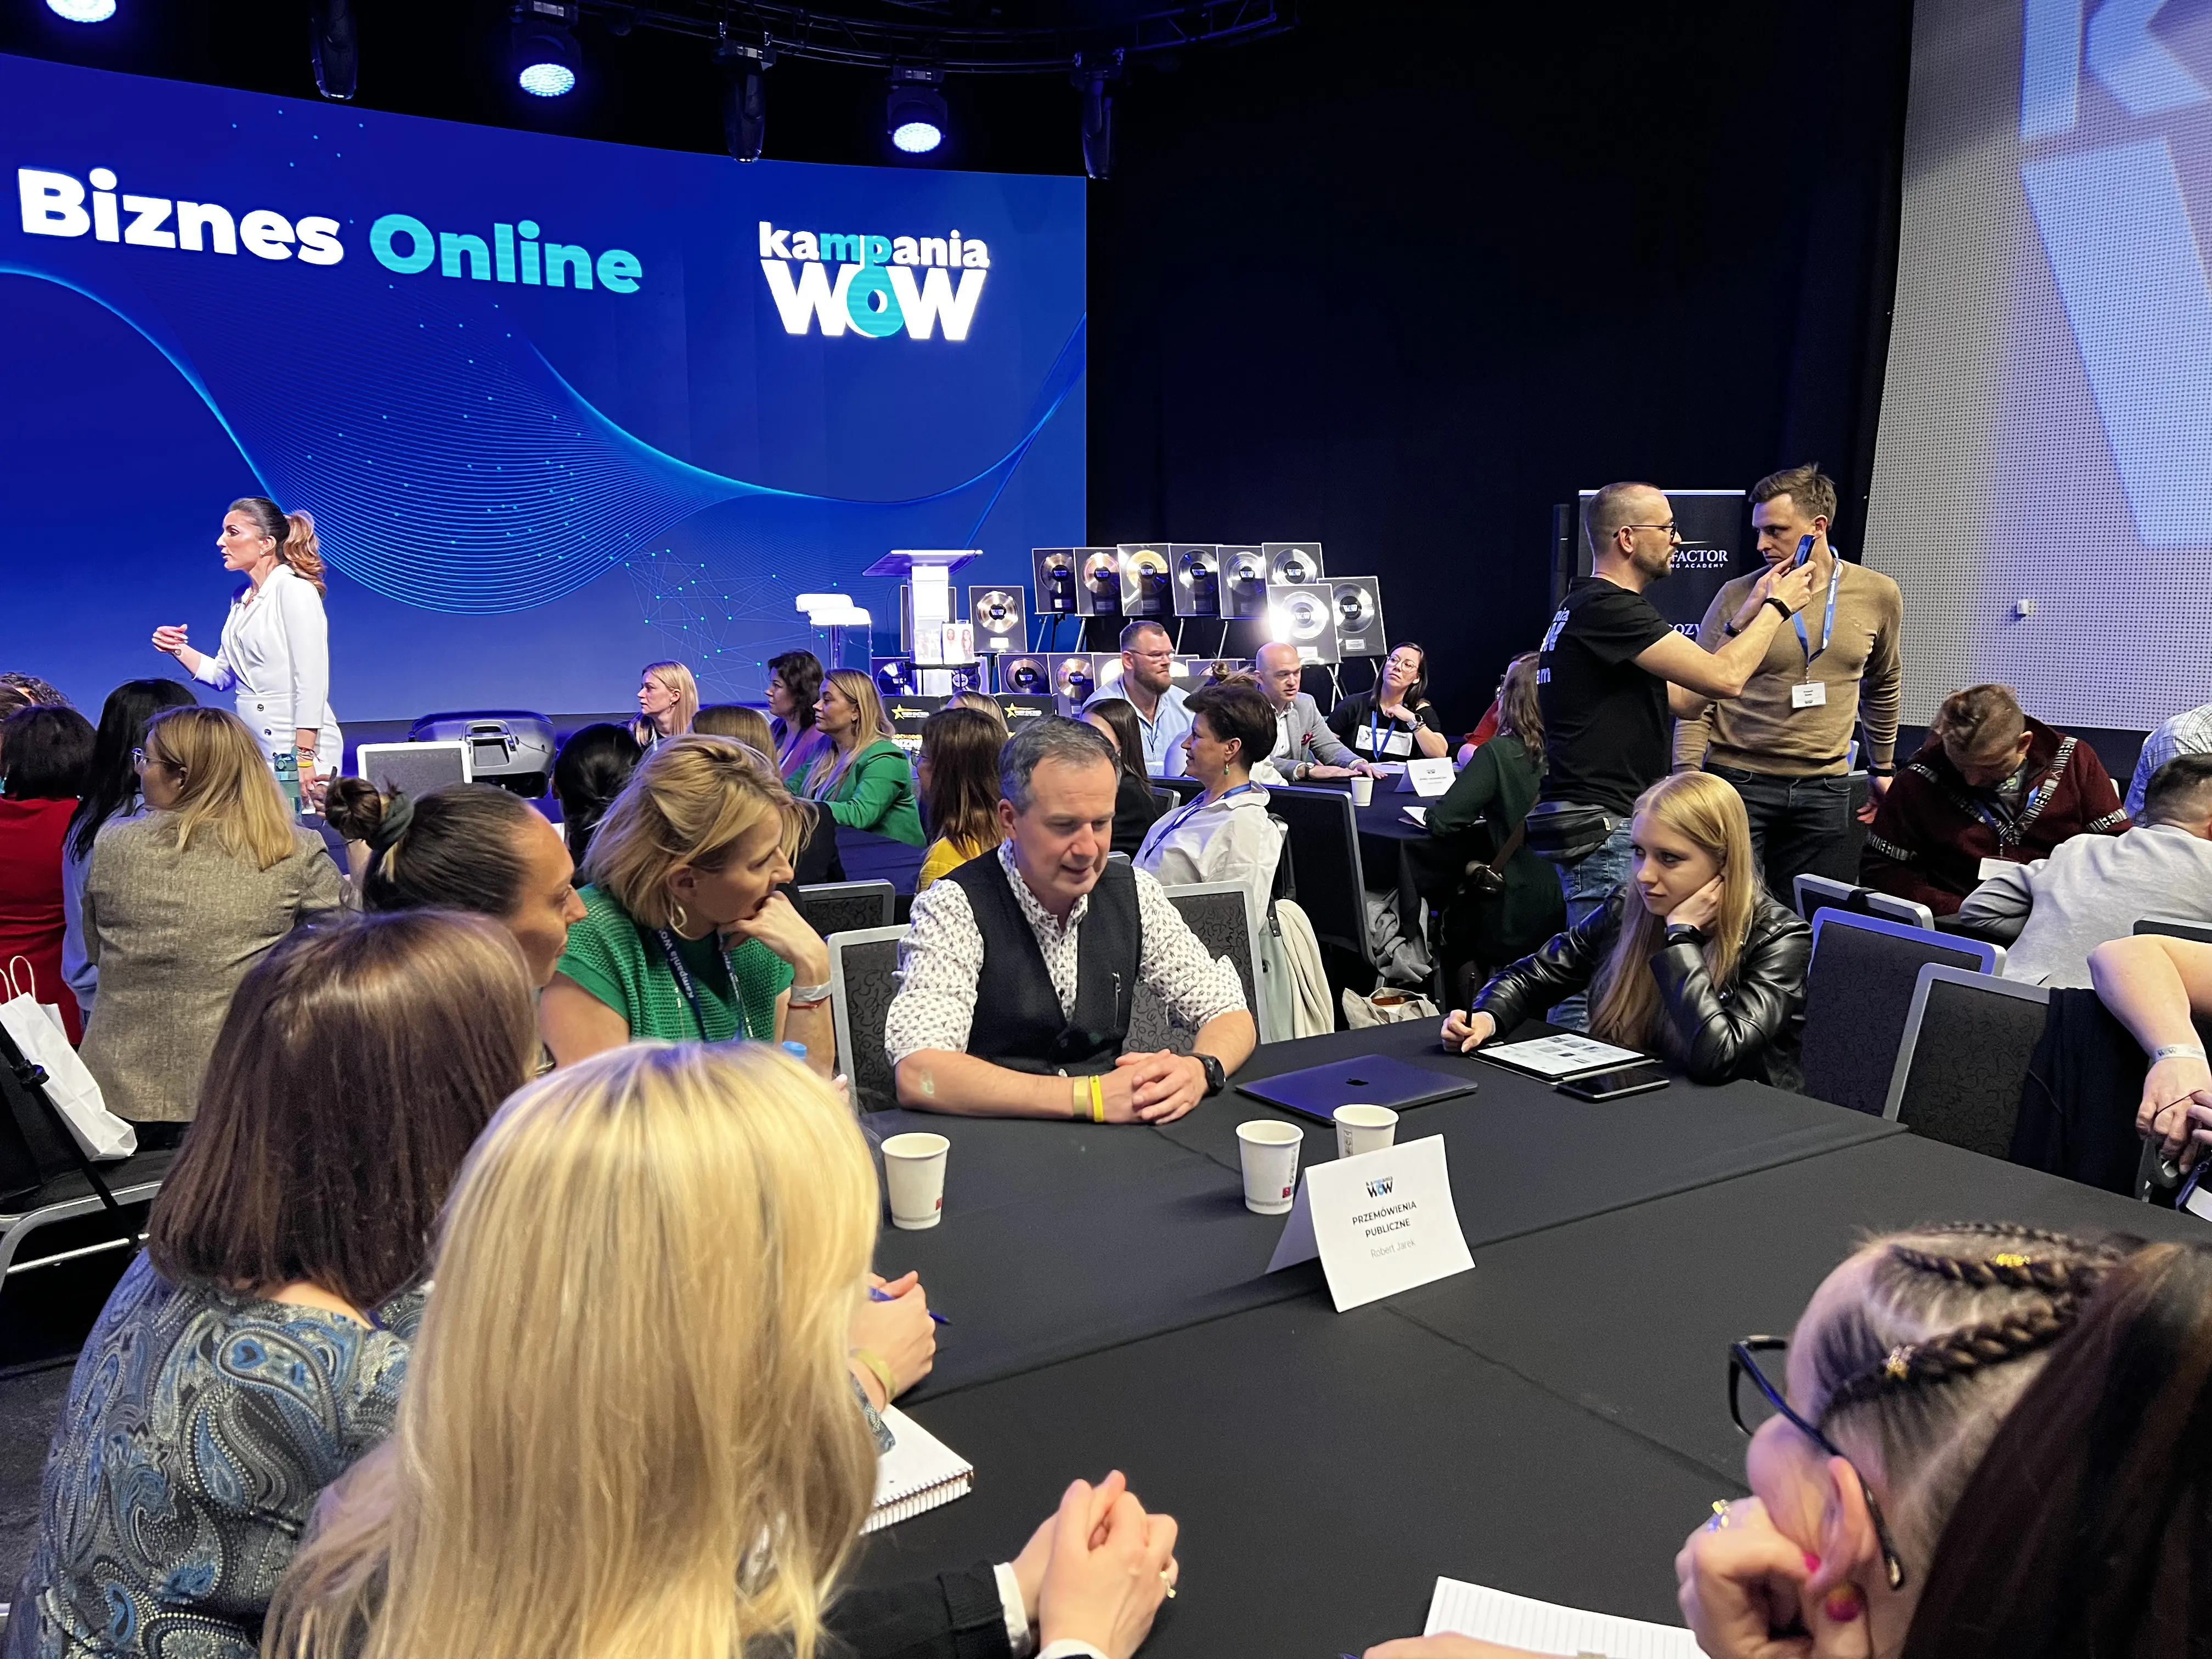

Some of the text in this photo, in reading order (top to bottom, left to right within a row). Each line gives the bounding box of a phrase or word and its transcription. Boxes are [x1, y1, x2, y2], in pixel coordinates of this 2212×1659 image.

[18, 167, 642, 294] Biznes Online
[759, 221, 990, 268] kampania
[761, 259, 987, 340] WOW
[1671, 550, 1728, 562] FACTOR
[659, 930, 694, 998] Kampania WO
[1367, 1181, 1393, 1198] WOW
[1352, 1200, 1417, 1225] PRZEMÓWIENIA
[1365, 1218, 1410, 1238] PUBLICZNE
[1370, 1238, 1416, 1258] Robert Jarek
